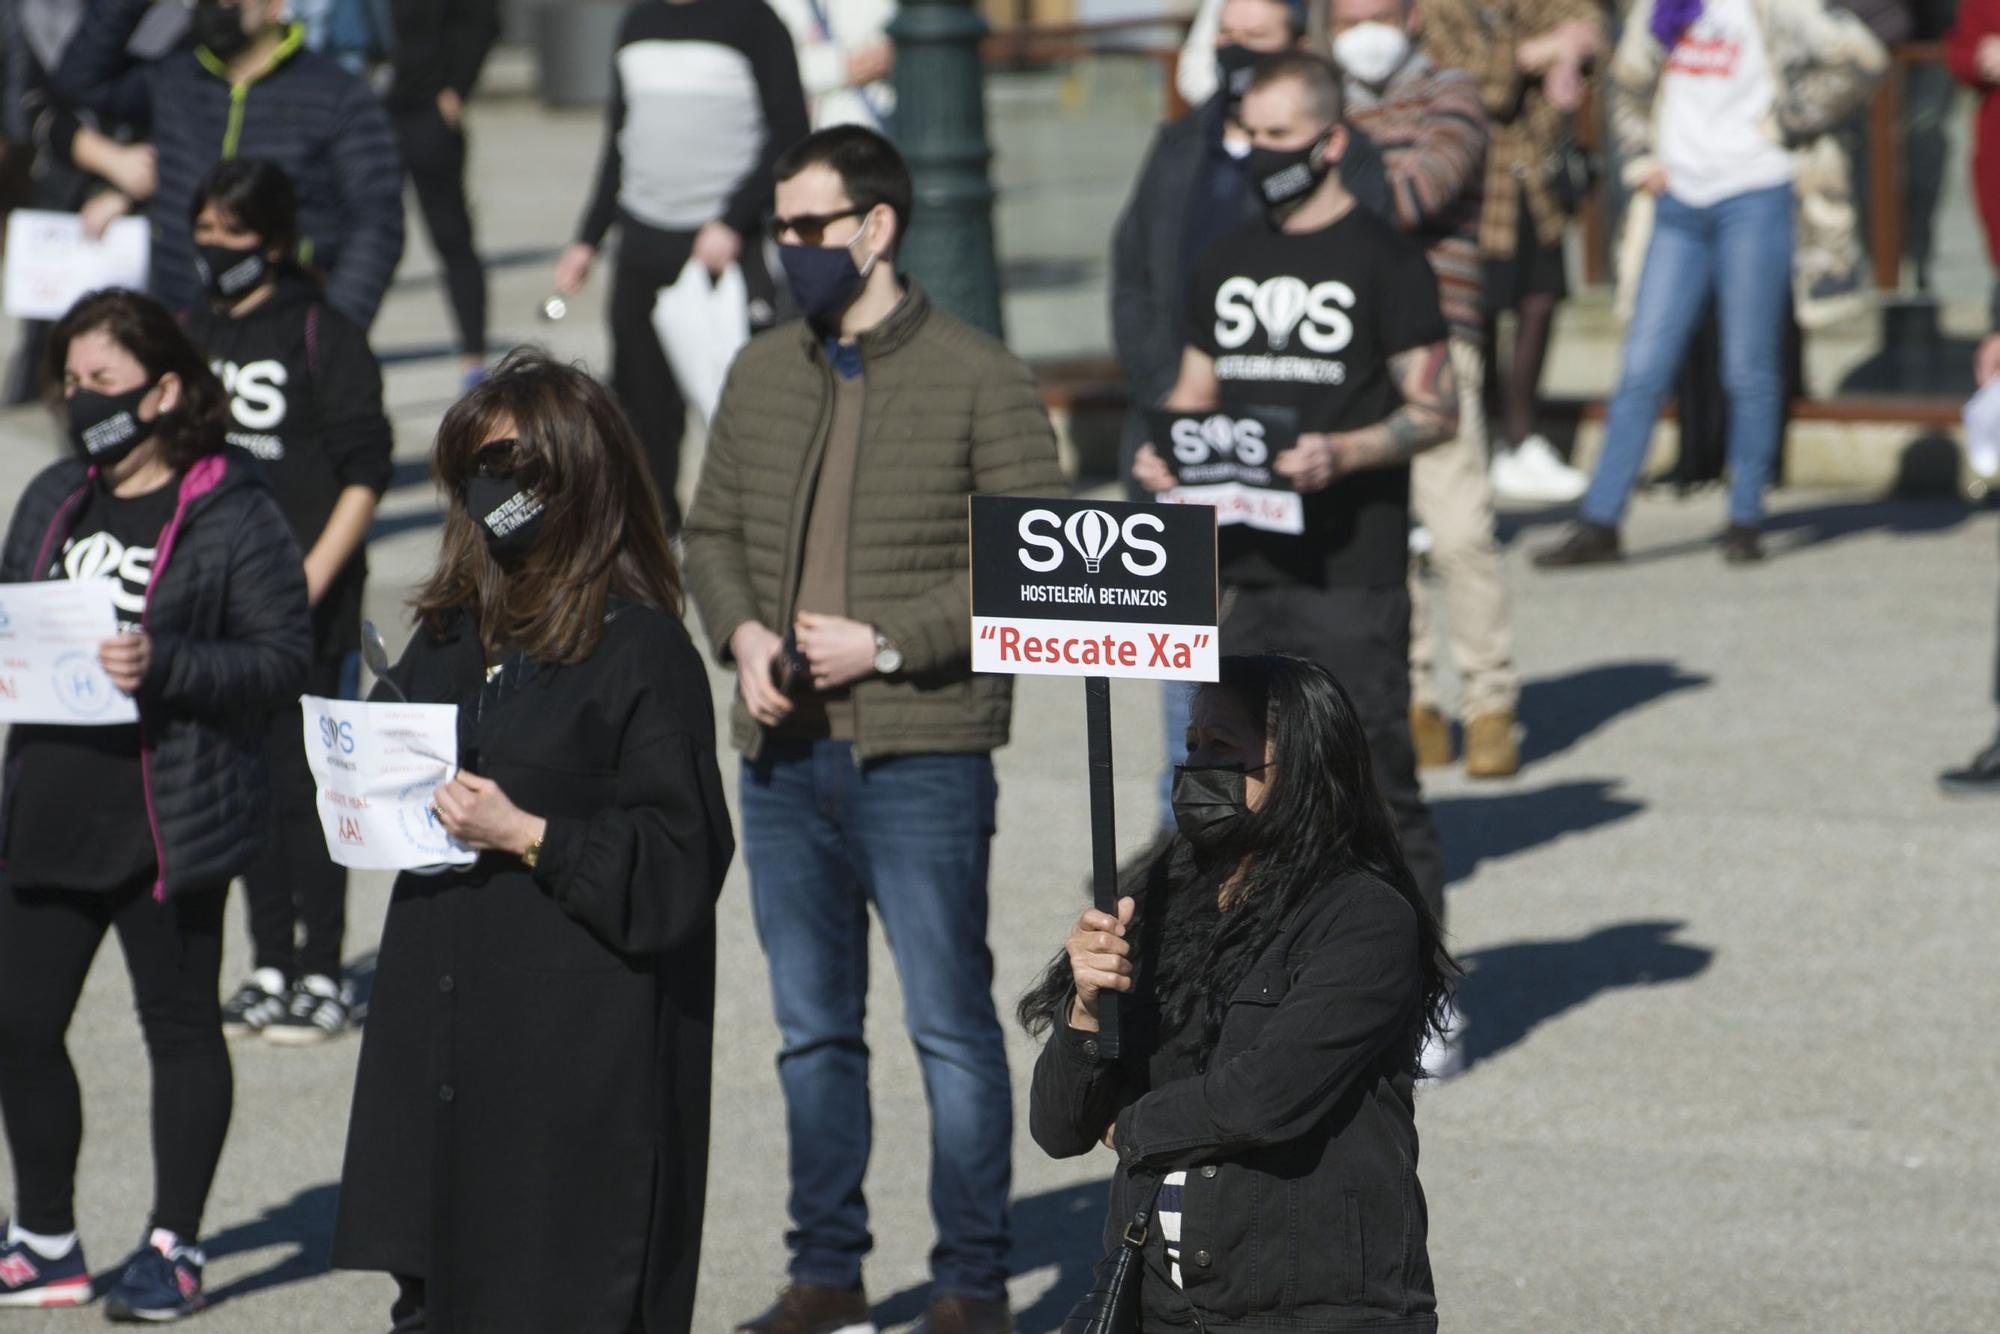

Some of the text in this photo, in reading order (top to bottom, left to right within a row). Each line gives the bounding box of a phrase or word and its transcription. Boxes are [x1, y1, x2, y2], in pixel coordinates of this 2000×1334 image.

[1214, 276, 1356, 353] SOS
[1171, 414, 1268, 465] SOS
[1018, 509, 1167, 576] SOS
[1021, 584, 1167, 606] HOSTELERÍA BETANZOS
